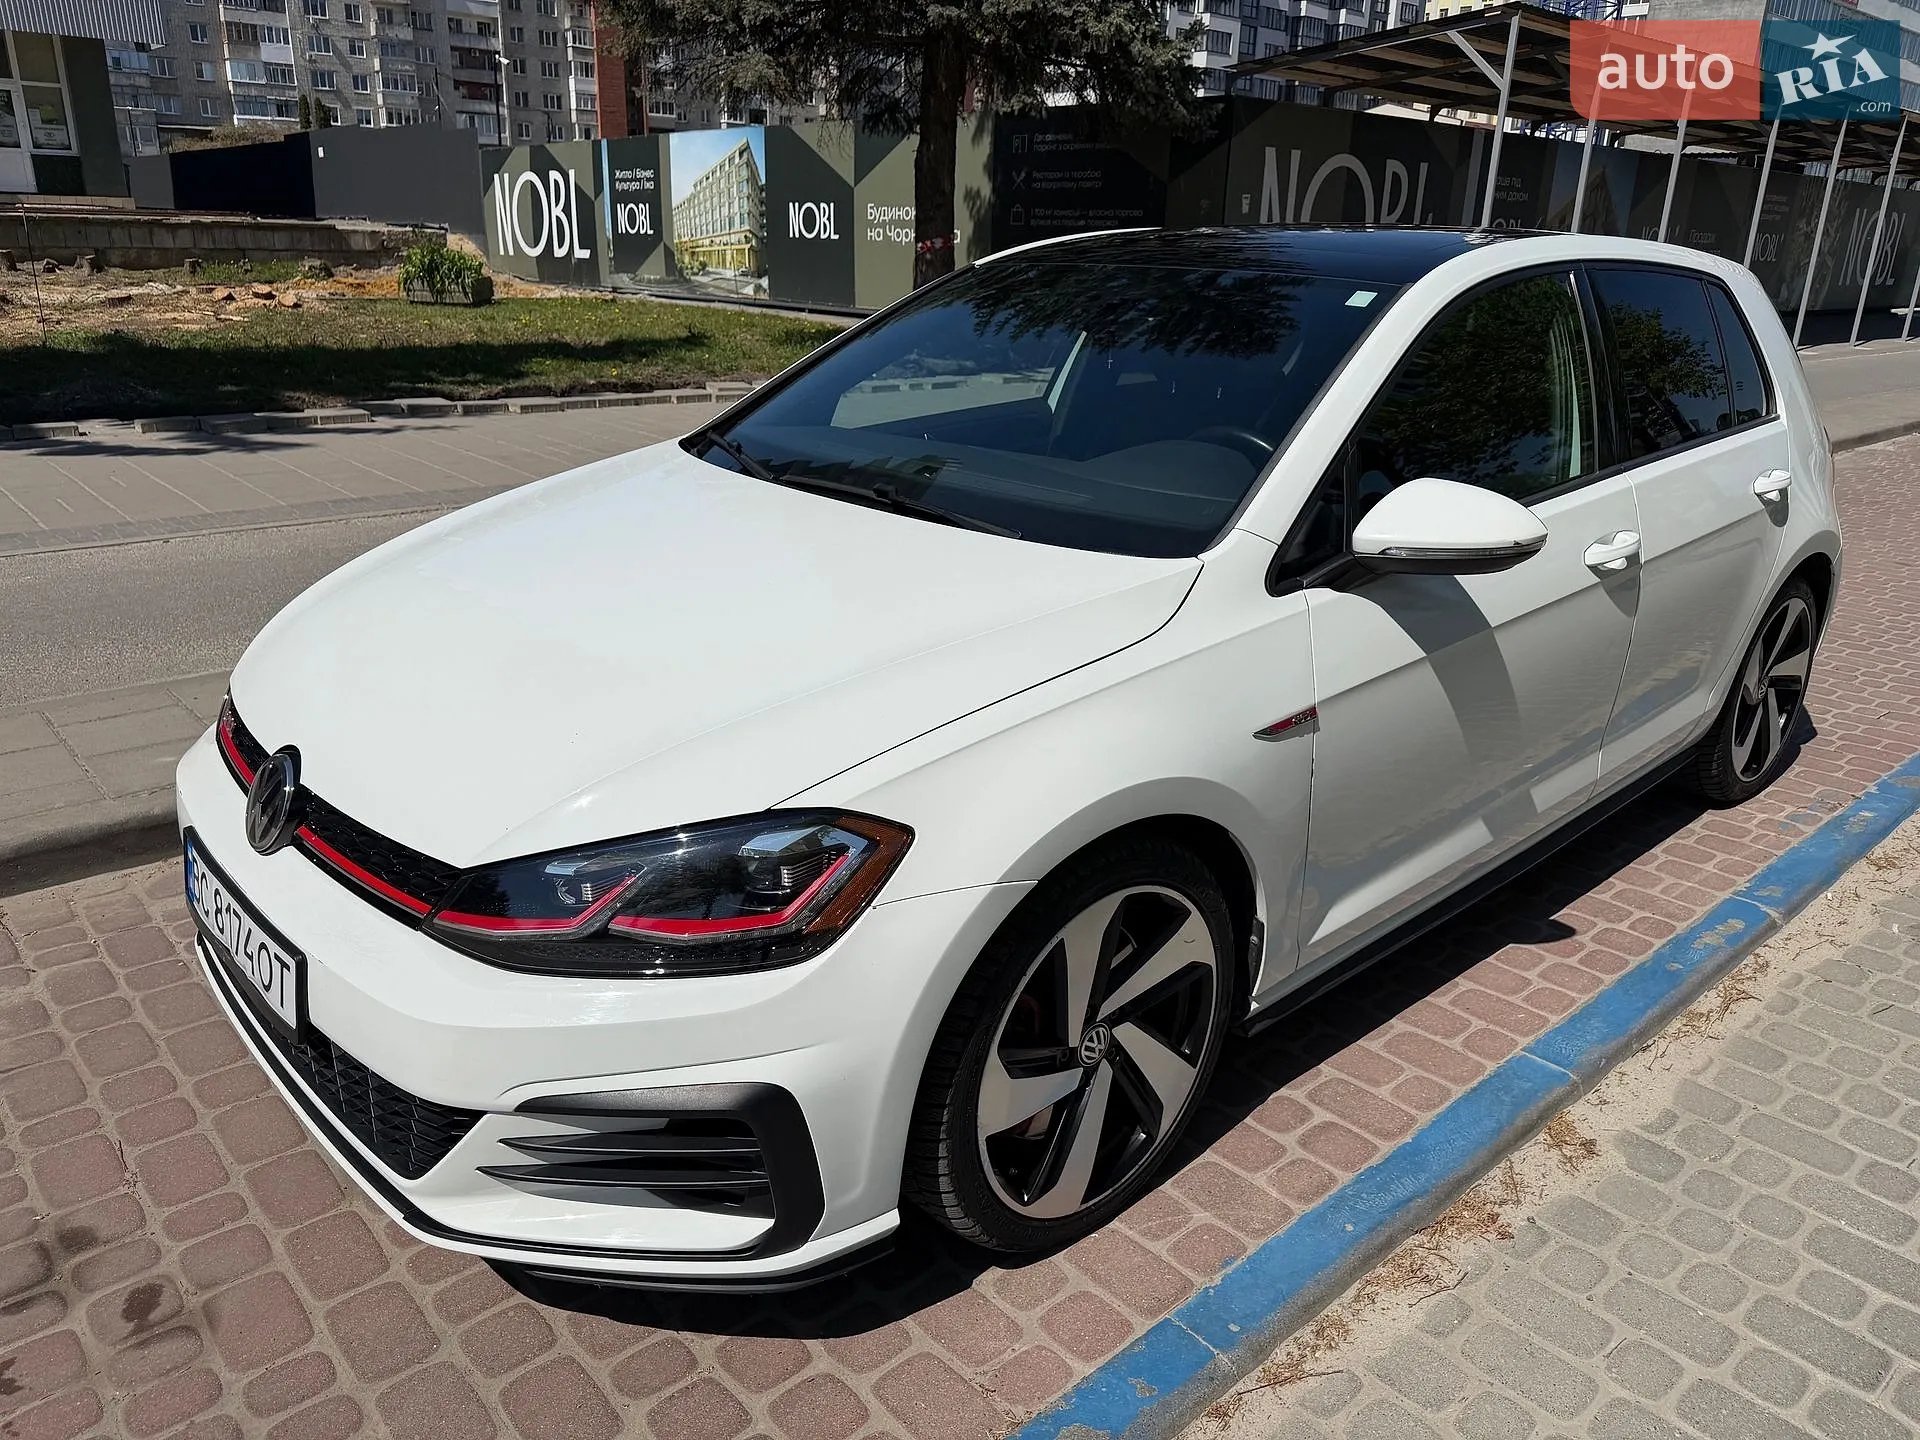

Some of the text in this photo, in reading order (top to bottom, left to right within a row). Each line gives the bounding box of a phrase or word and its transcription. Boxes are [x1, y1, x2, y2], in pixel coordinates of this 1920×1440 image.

[493, 168, 591, 260] NOBL
[617, 203, 654, 235] NOBL
[788, 201, 839, 240] NOBL
[867, 228, 884, 241] на
